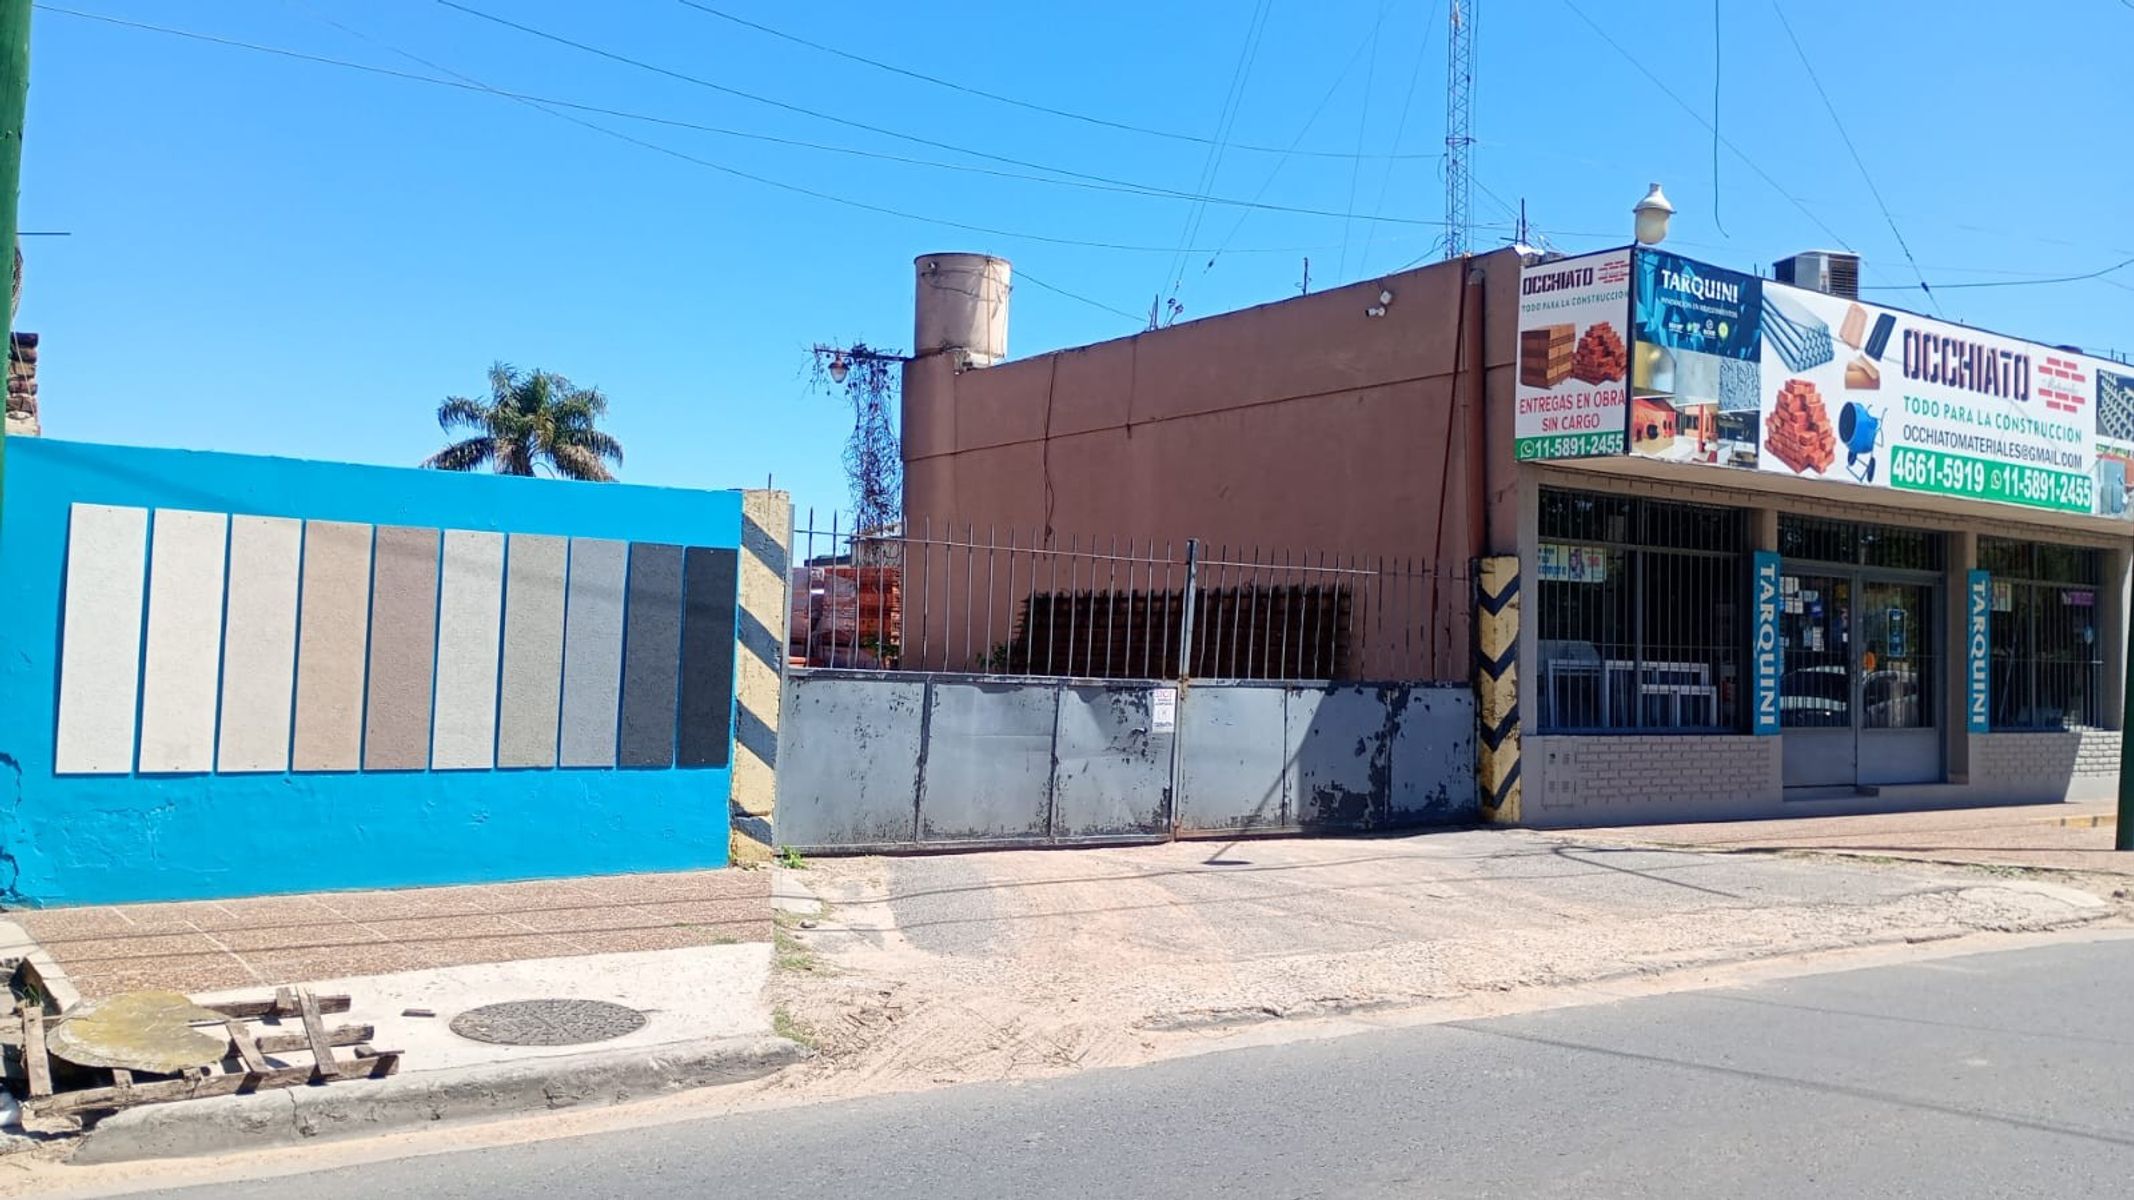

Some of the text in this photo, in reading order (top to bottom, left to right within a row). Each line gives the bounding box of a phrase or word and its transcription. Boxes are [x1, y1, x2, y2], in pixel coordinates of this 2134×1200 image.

[1522, 267, 1594, 296] OCCHIATO
[1661, 269, 1738, 304] TARQUINI
[1521, 303, 1541, 313] TODO
[1543, 300, 1560, 311] PARA
[1561, 299, 1570, 308] LA
[1903, 329, 2030, 402] OCCHIATO
[1520, 388, 1626, 414] ENTREGAS EN OBRA
[1903, 395, 1940, 417] TODO
[1943, 403, 1974, 424] PARA
[1977, 408, 1992, 426] LA
[1542, 413, 1601, 432] SIN CARGO
[1535, 434, 1624, 457] 11-5891-2455
[1903, 424, 2083, 469] OCCHIATOMATERIALES@GMAIL.COM
[1892, 450, 2092, 507] 4661-5919 11-5891-2455
[1757, 563, 1776, 724] TARQUINI
[1971, 579, 1986, 723] TARQUINI
